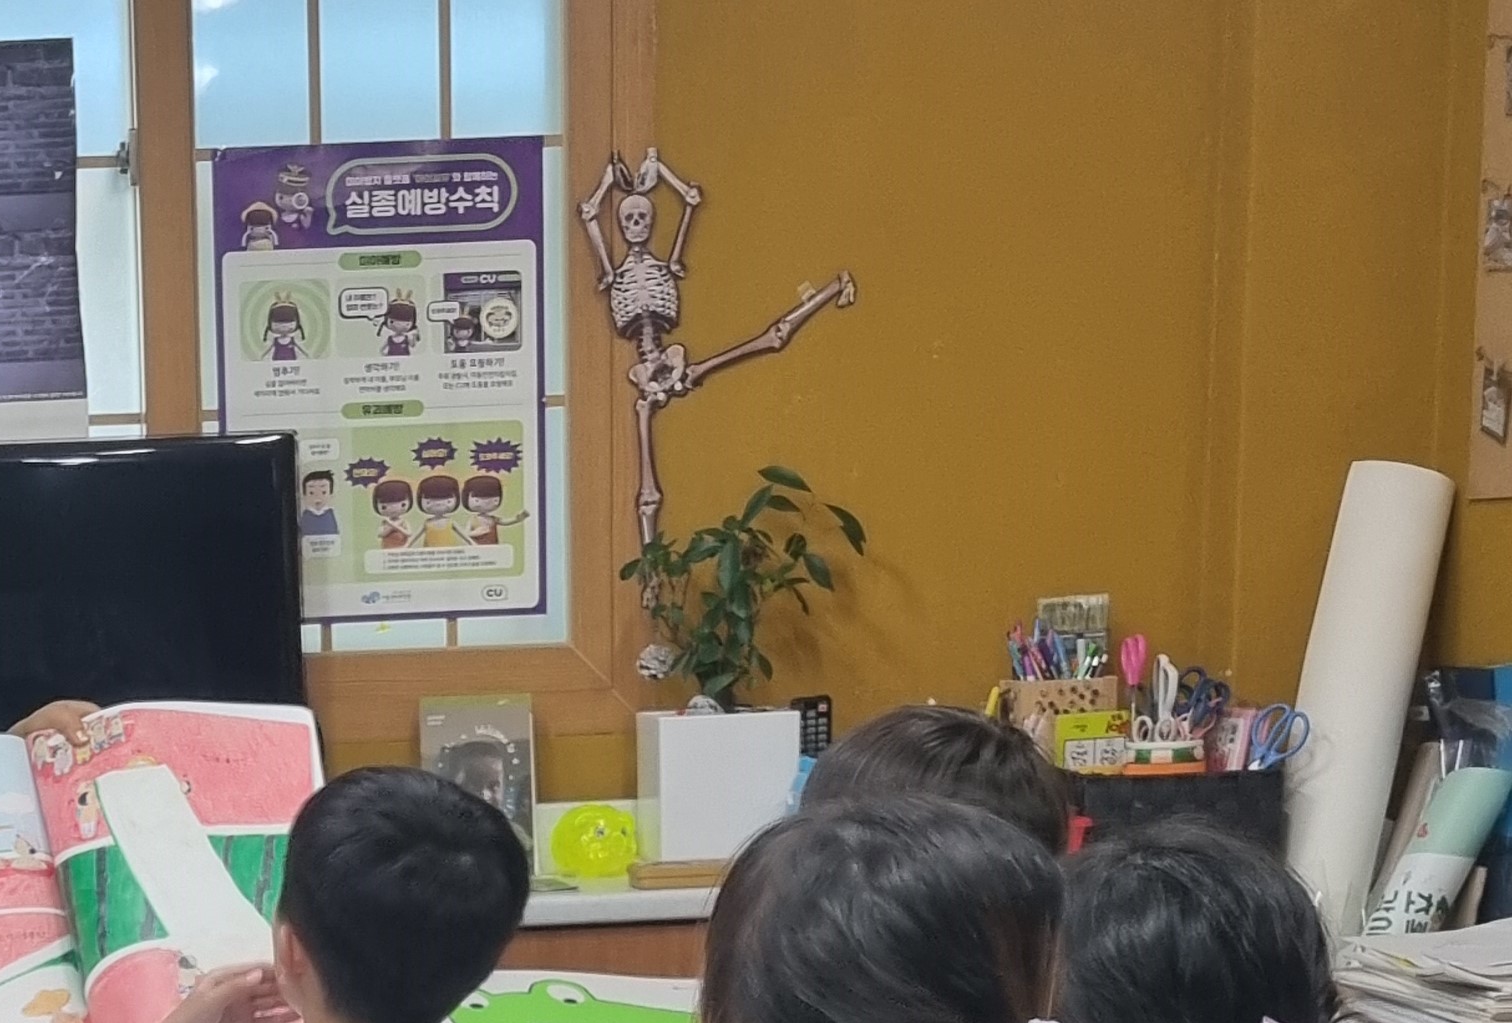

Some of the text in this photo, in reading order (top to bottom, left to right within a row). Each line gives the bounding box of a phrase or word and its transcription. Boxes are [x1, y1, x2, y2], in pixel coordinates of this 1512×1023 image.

[344, 185, 500, 218] 실종예방수칙
[479, 274, 497, 284] CU
[486, 589, 503, 598] CU
